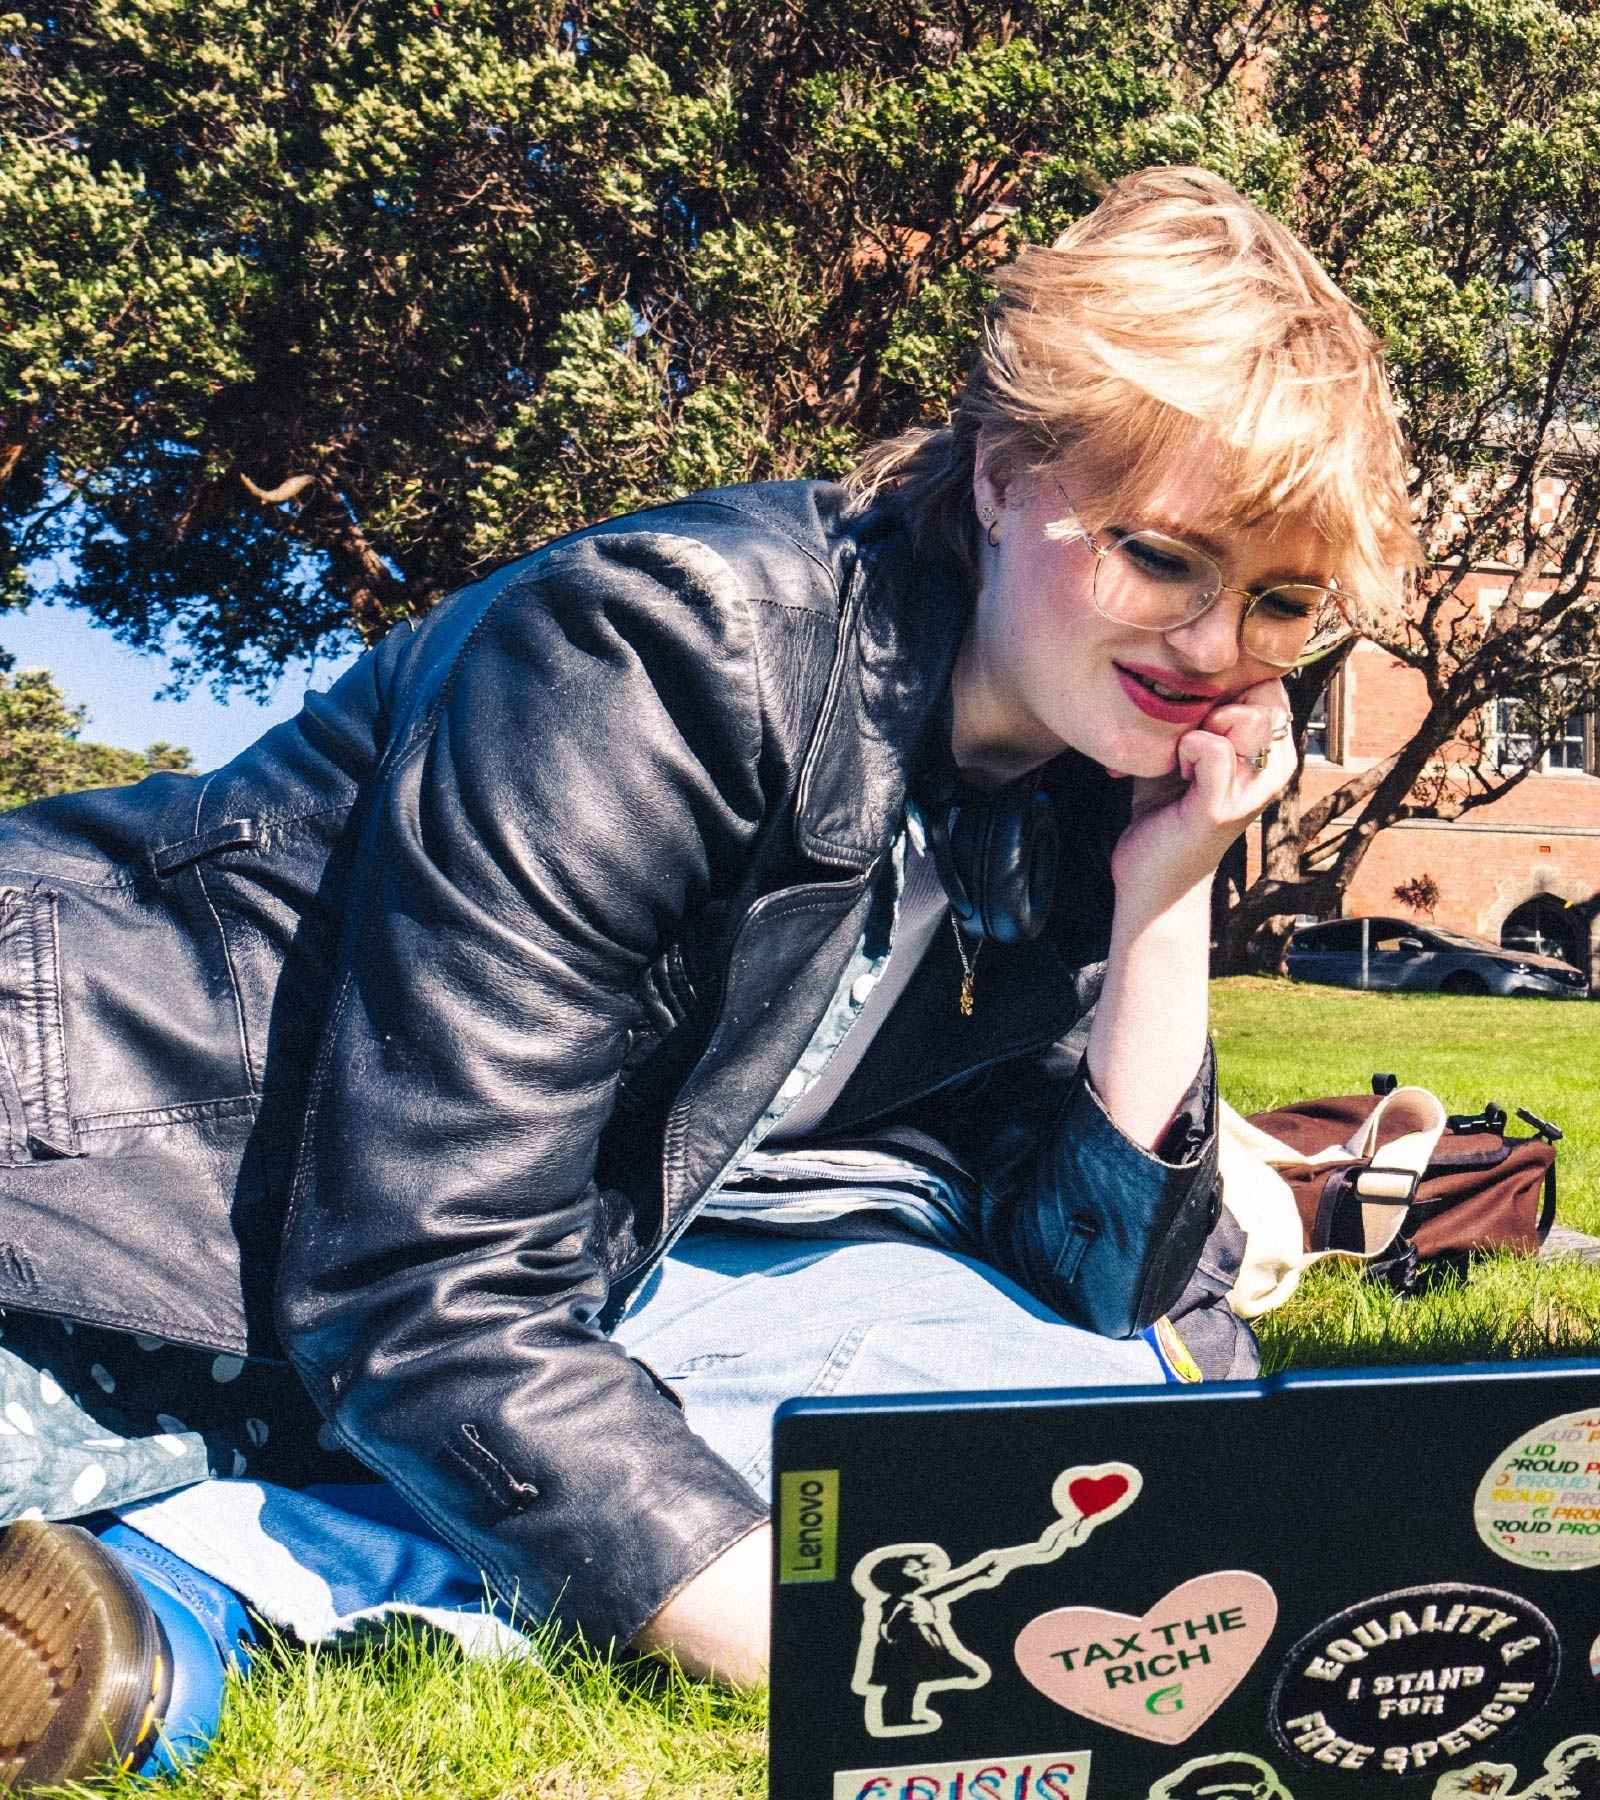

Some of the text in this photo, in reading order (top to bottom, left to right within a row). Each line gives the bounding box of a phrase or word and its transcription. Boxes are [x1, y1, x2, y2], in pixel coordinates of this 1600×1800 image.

[791, 1480, 824, 1572] Lenovo
[1049, 1606, 1247, 1672] TAX THE
[1103, 1644, 1212, 1689] RICH
[1304, 1604, 1518, 1681] EQUALITY
[1347, 1665, 1486, 1700] I STAND
[1378, 1694, 1446, 1720] FOR
[1285, 1681, 1536, 1775] FREE SPEECH
